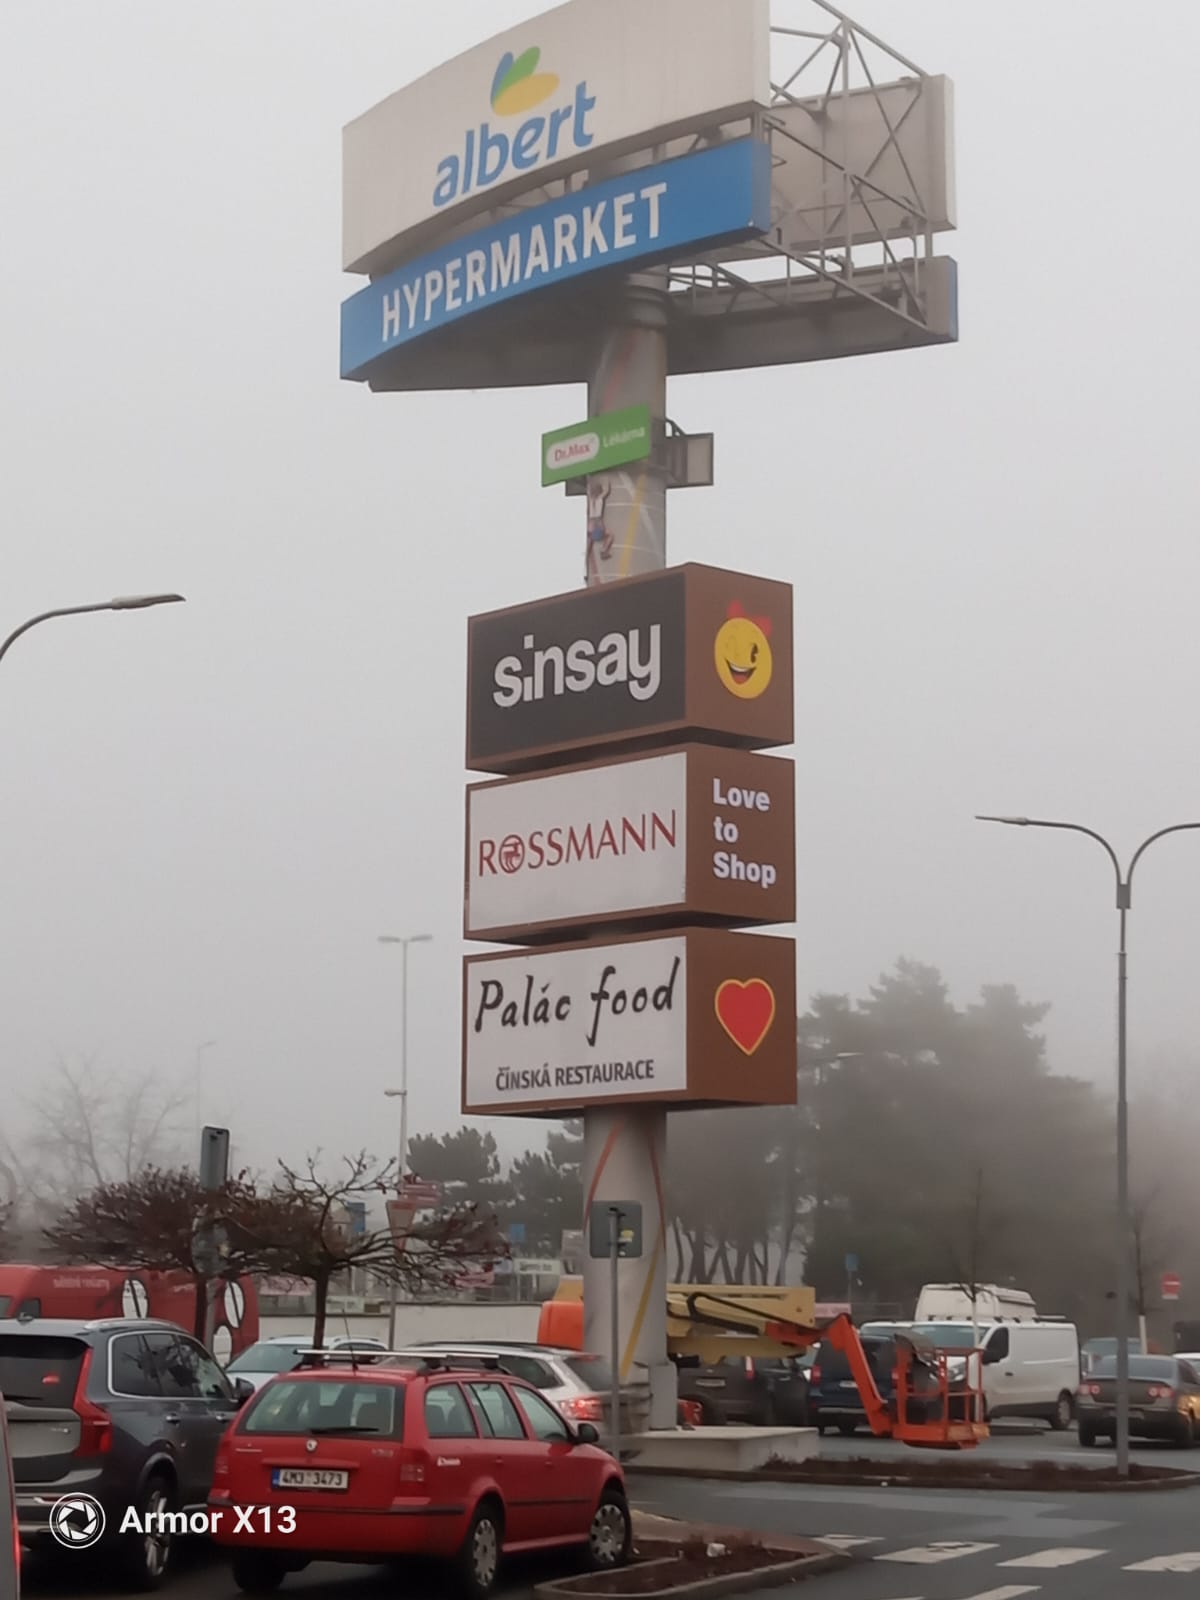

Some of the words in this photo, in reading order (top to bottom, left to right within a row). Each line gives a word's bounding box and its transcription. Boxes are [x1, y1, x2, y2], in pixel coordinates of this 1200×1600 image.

[432, 80, 597, 207] albert
[381, 182, 667, 343] HYPERMARKET
[493, 624, 661, 707] sinsay
[712, 777, 770, 811] Love
[478, 809, 676, 877] ROSSMANN
[713, 815, 739, 843] to
[712, 852, 777, 888] Shop
[475, 974, 571, 1033] Palác
[585, 956, 681, 1048] food
[495, 1063, 552, 1091] ČÍNSKÁ
[555, 1059, 655, 1087] RESTAURACE
[313, 1472, 343, 1486] 3473
